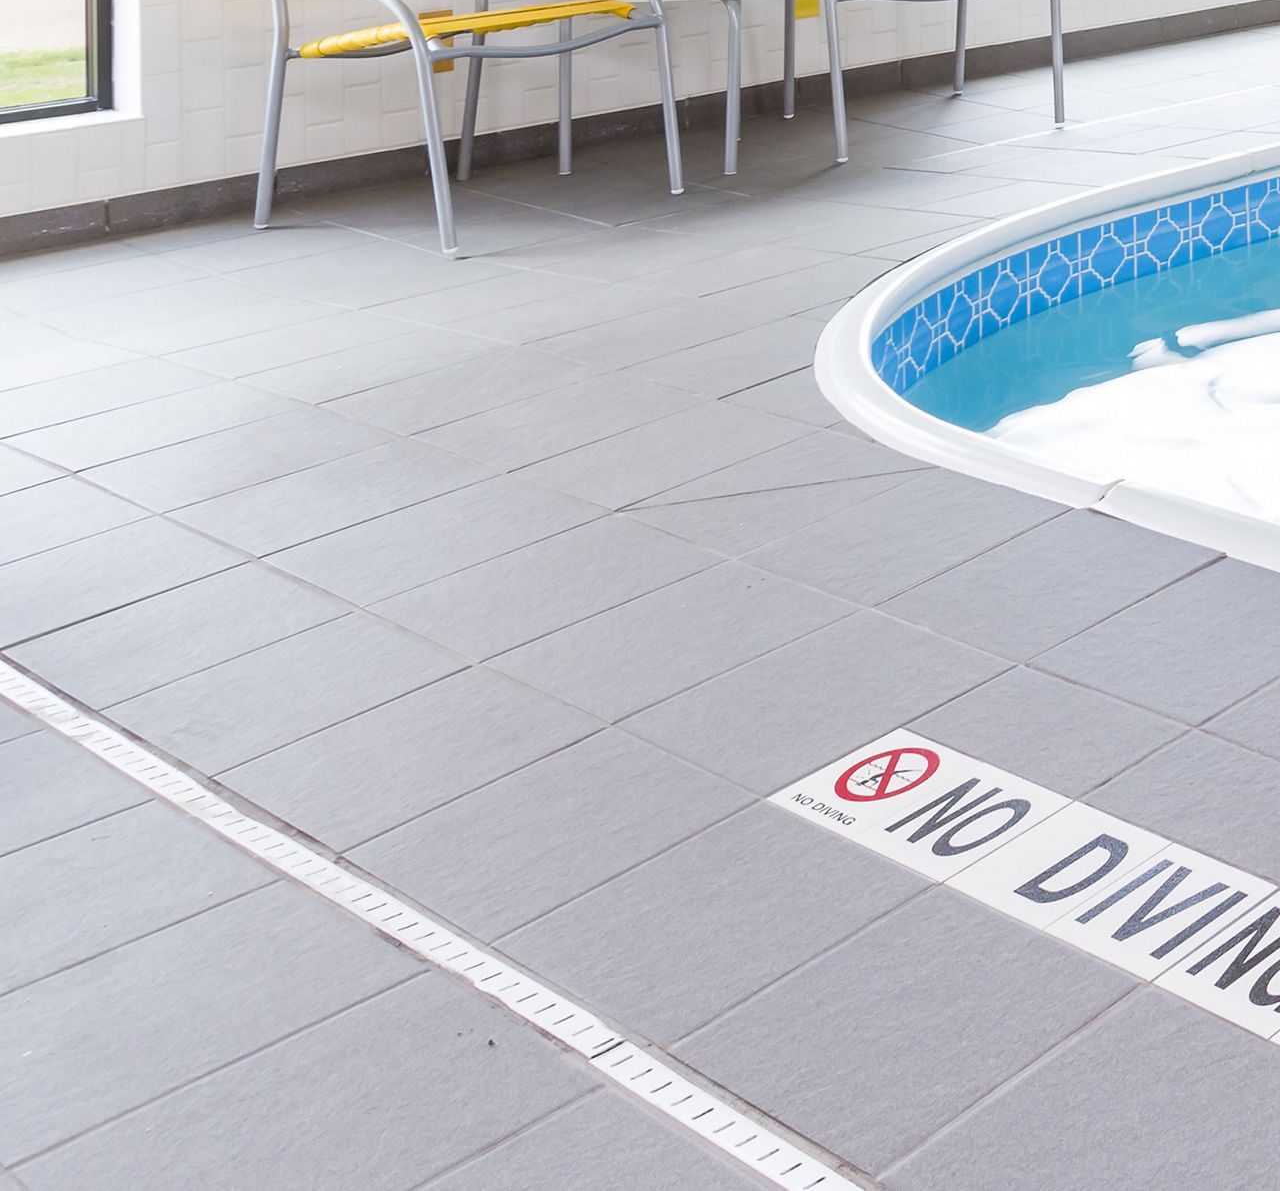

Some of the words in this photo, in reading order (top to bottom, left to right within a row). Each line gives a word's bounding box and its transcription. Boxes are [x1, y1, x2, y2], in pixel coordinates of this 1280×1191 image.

[790, 793, 814, 806] NO
[811, 802, 856, 826] DIVING
[885, 777, 1031, 857] NO
